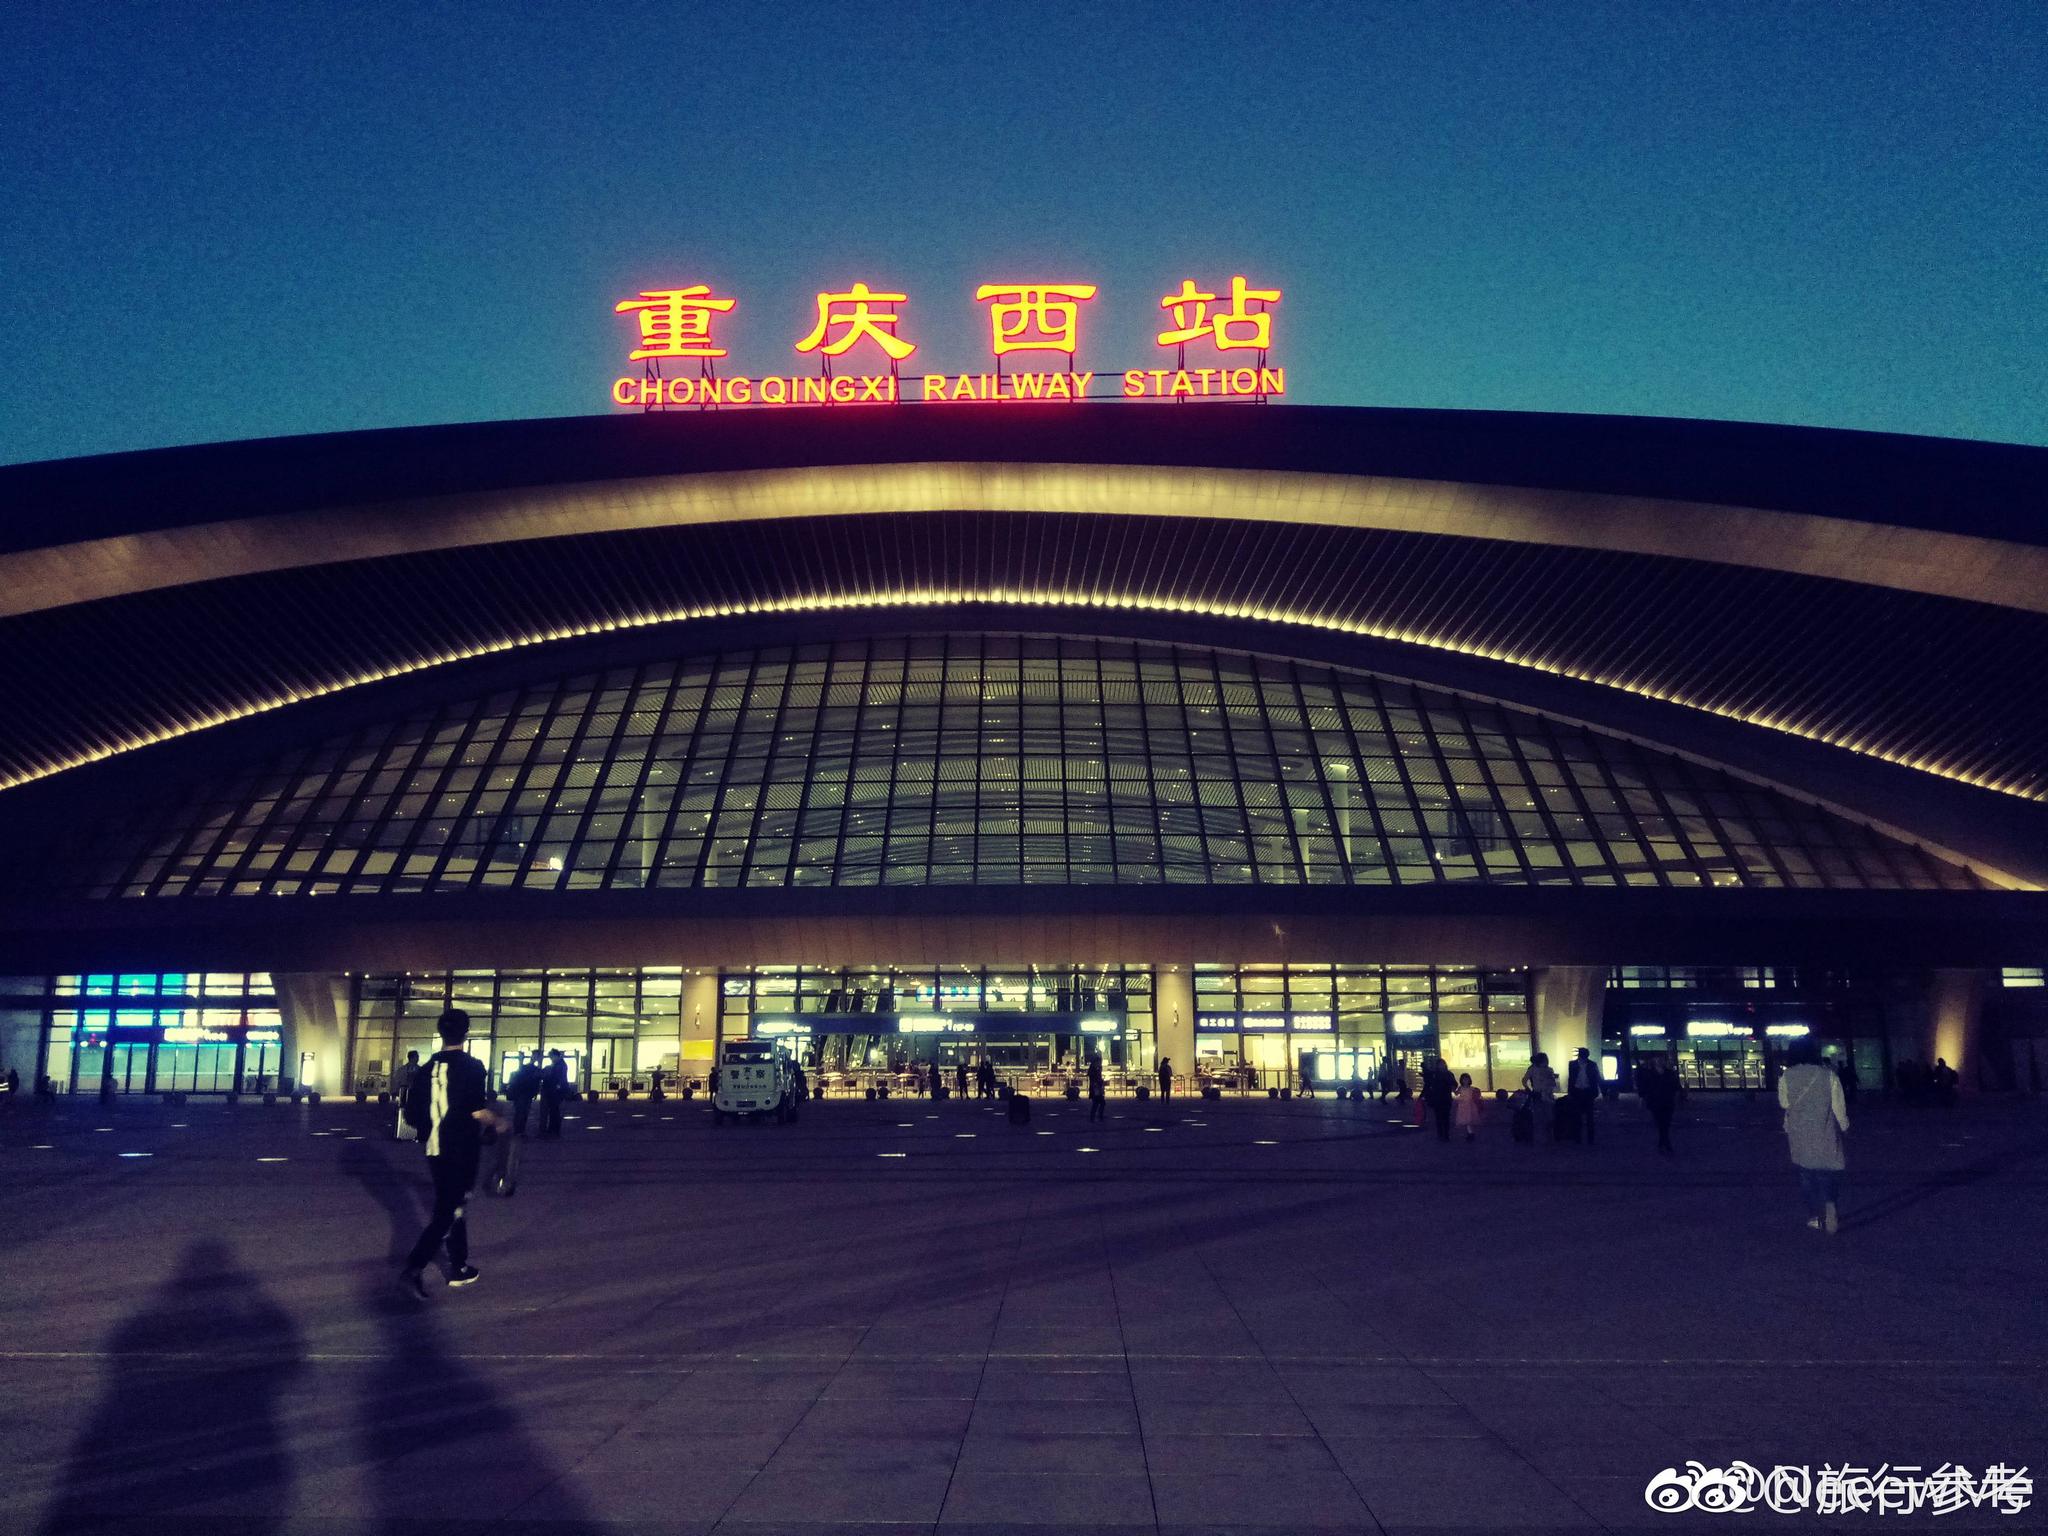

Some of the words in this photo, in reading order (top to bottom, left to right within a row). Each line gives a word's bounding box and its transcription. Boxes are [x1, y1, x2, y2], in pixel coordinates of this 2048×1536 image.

[614, 276, 1283, 361] 重庆西站
[612, 376, 896, 404] CHONGQINGXI
[922, 370, 1093, 401] RAILWAY
[1120, 367, 1285, 397] STATION
